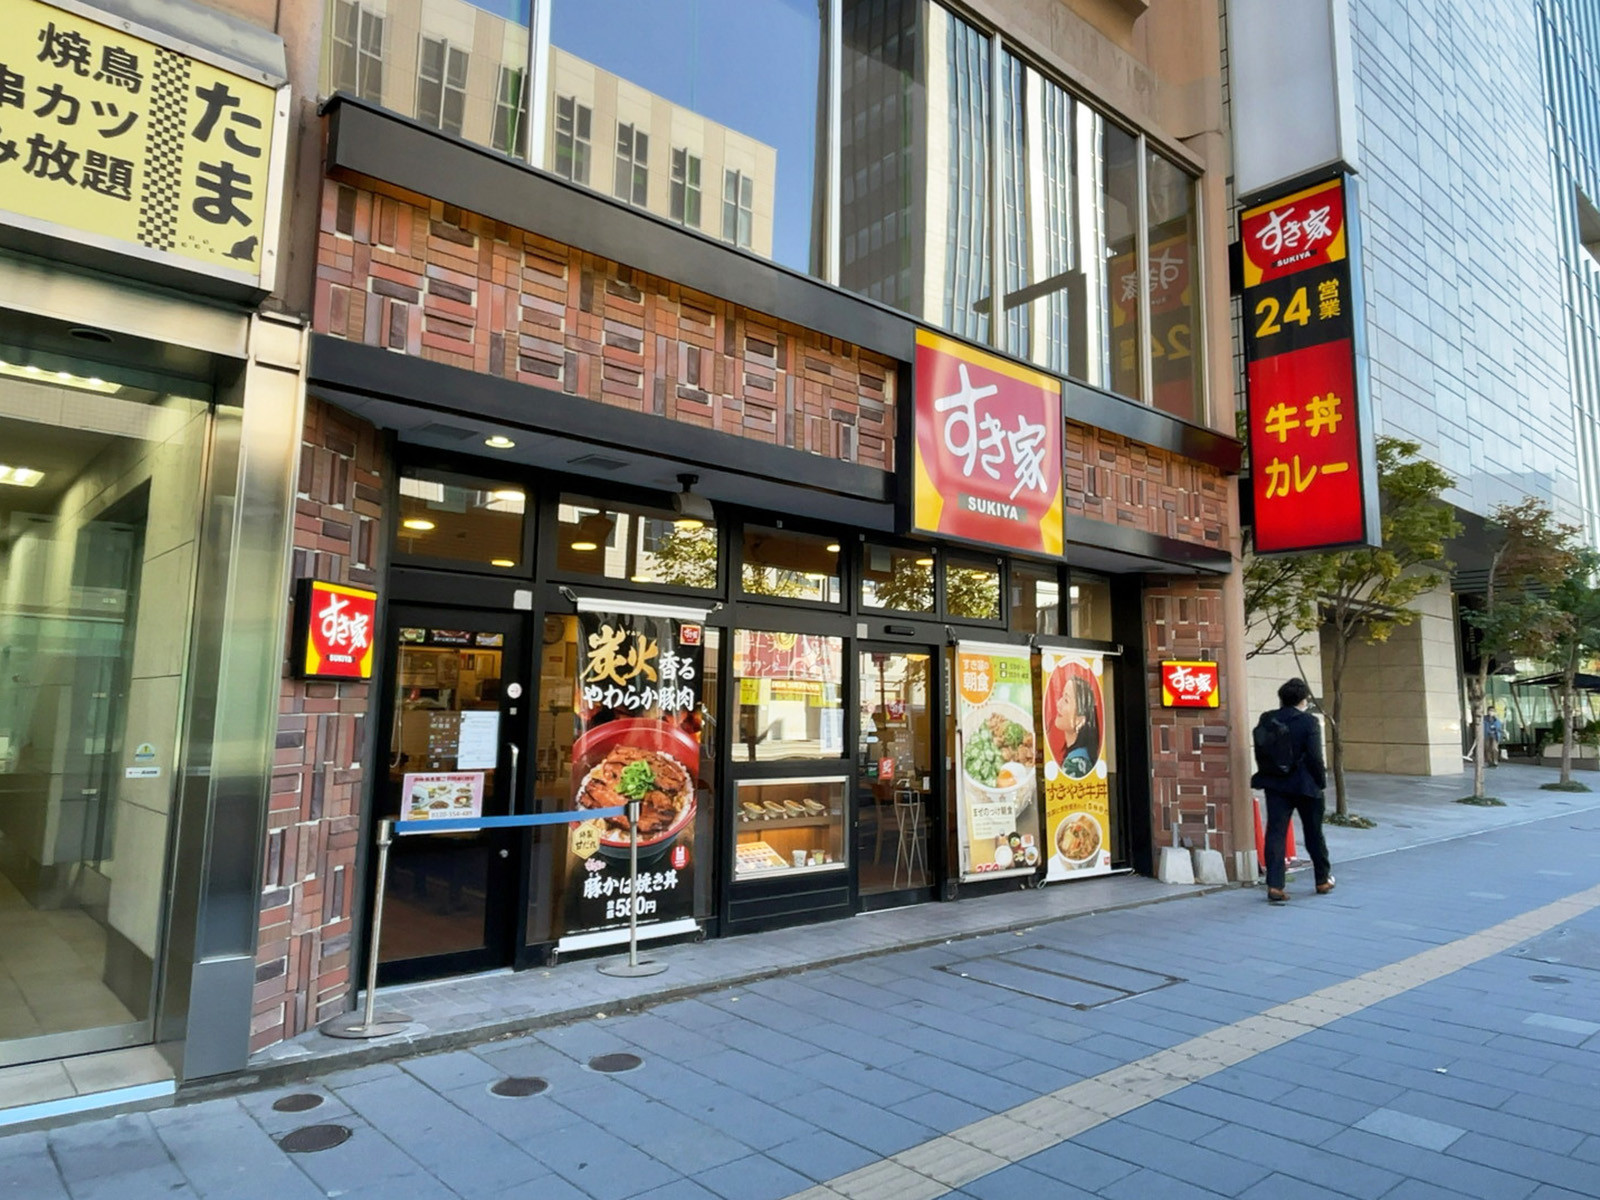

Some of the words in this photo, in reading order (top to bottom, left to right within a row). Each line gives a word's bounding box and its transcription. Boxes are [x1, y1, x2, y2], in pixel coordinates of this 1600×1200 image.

[37, 21, 144, 94] 焼鳥
[191, 81, 262, 227] たま
[1255, 205, 1333, 255] すき家
[1276, 250, 1312, 267] SUKIYA
[1255, 286, 1312, 338] 24
[1318, 277, 1341, 320] 営業
[934, 363, 1048, 500] すき家
[1265, 392, 1342, 443] 牛丼
[1265, 455, 1349, 499] カレー
[968, 496, 1019, 520] SUKIYA
[318, 593, 369, 654] すき家
[583, 685, 695, 712] やわらか豚肉
[963, 672, 989, 692] 朝食
[1168, 665, 1212, 695] すき家
[1047, 782, 1107, 801] すきやき牛丼
